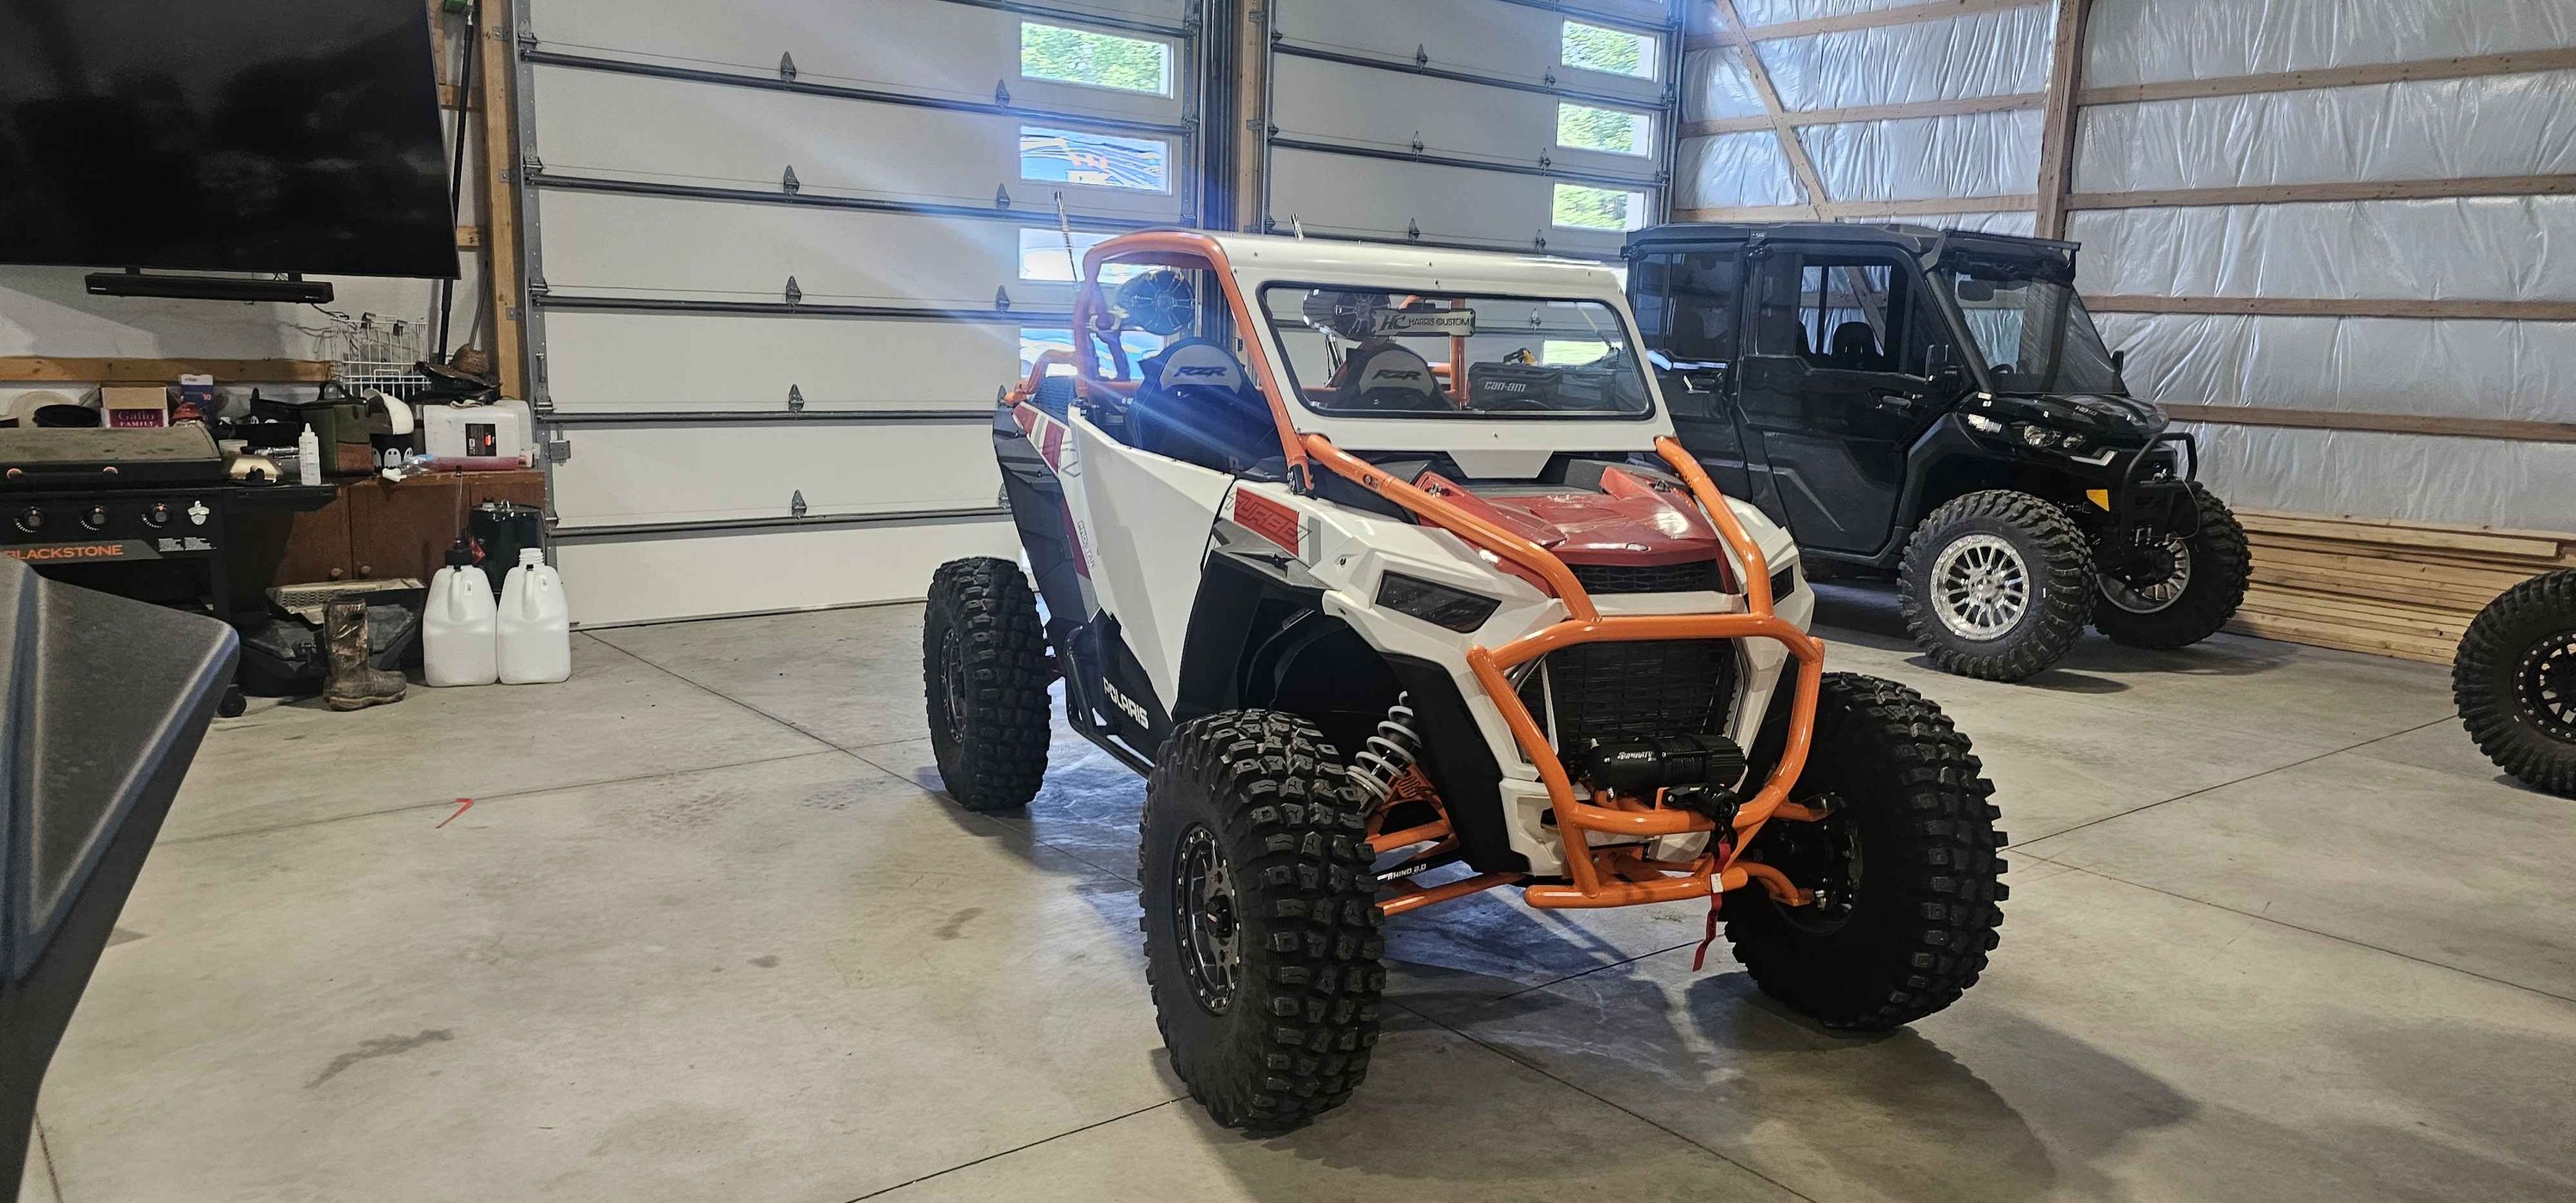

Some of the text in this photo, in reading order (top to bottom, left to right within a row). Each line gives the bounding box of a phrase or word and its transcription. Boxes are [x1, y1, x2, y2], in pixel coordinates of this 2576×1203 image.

[1408, 317, 1469, 327] HARRIS CUSTOM
[1173, 365, 1228, 377] RZR
[1371, 370, 1421, 381] RZR
[1484, 381, 1526, 393] can-am
[118, 410, 155, 421] Gallo
[1225, 491, 1312, 547] TURBO
[3, 544, 124, 560] BLACKSTONE
[1102, 676, 1150, 730] POLARIS
